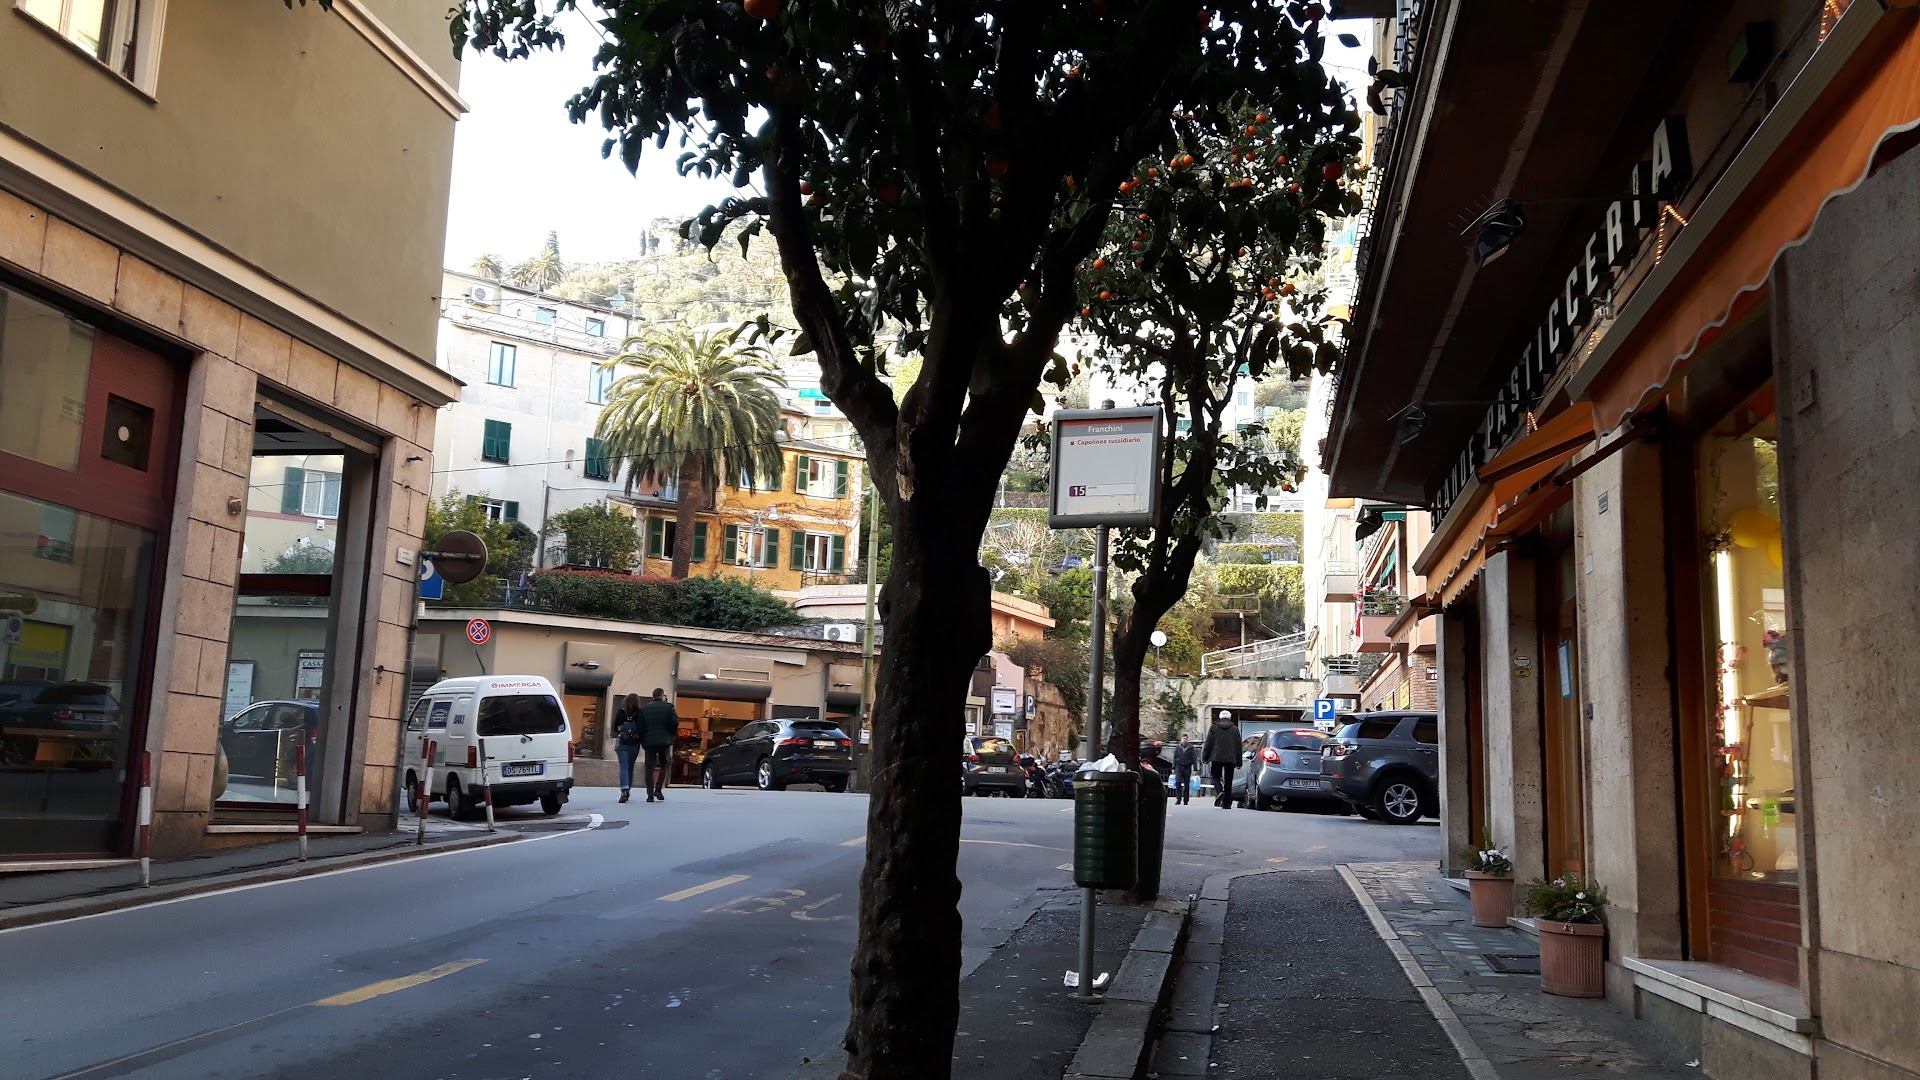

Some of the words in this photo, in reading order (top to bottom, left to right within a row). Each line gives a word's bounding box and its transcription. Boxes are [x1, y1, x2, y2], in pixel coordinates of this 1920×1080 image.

[1430, 434, 1475, 533] GRANDE
[1486, 118, 1673, 448] PASTICCERIA
[1088, 425, 1123, 433] Franchini
[1073, 486, 1085, 496] 15
[1318, 701, 1331, 718] P
